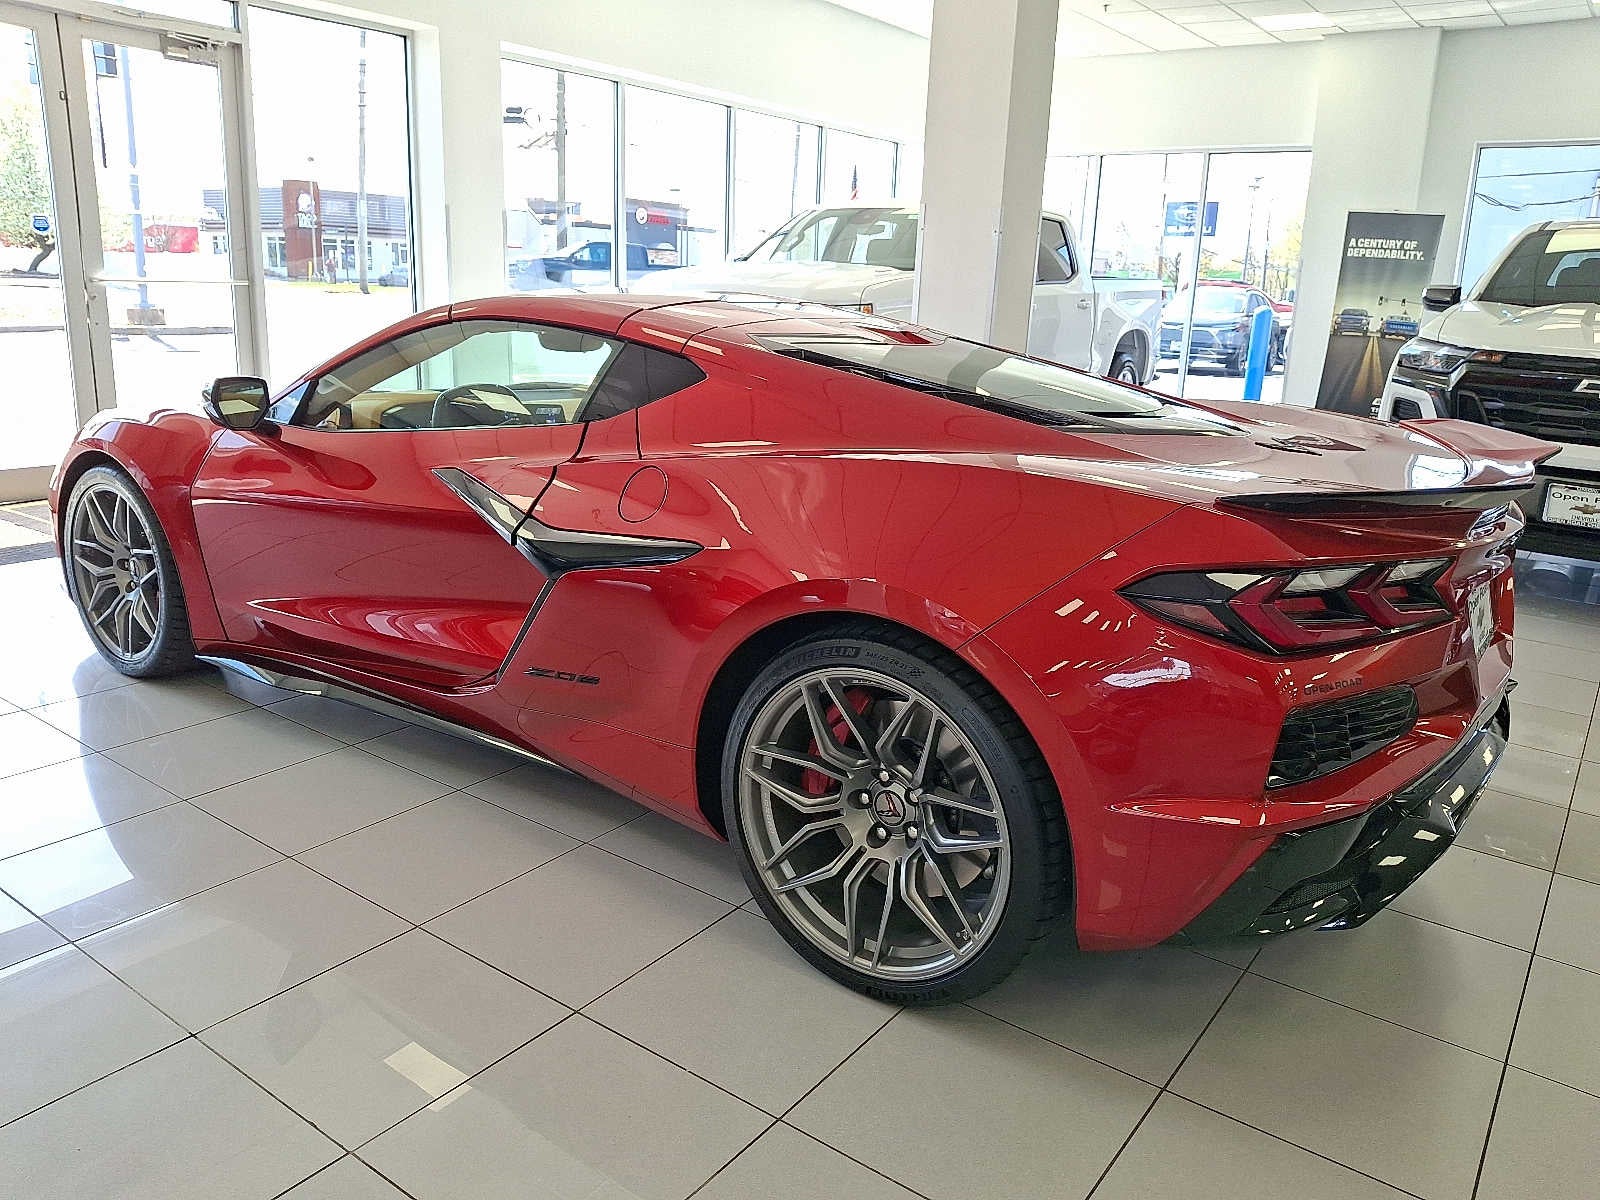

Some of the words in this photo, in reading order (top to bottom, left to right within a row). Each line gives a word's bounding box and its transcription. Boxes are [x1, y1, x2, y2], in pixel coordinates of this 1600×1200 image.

[1349, 238, 1357, 247] A
[1357, 238, 1403, 249] CENTURY
[1403, 240, 1418, 250] OF
[1347, 247, 1425, 260] DEPENDABILITY.
[1552, 492, 1589, 502] Open
